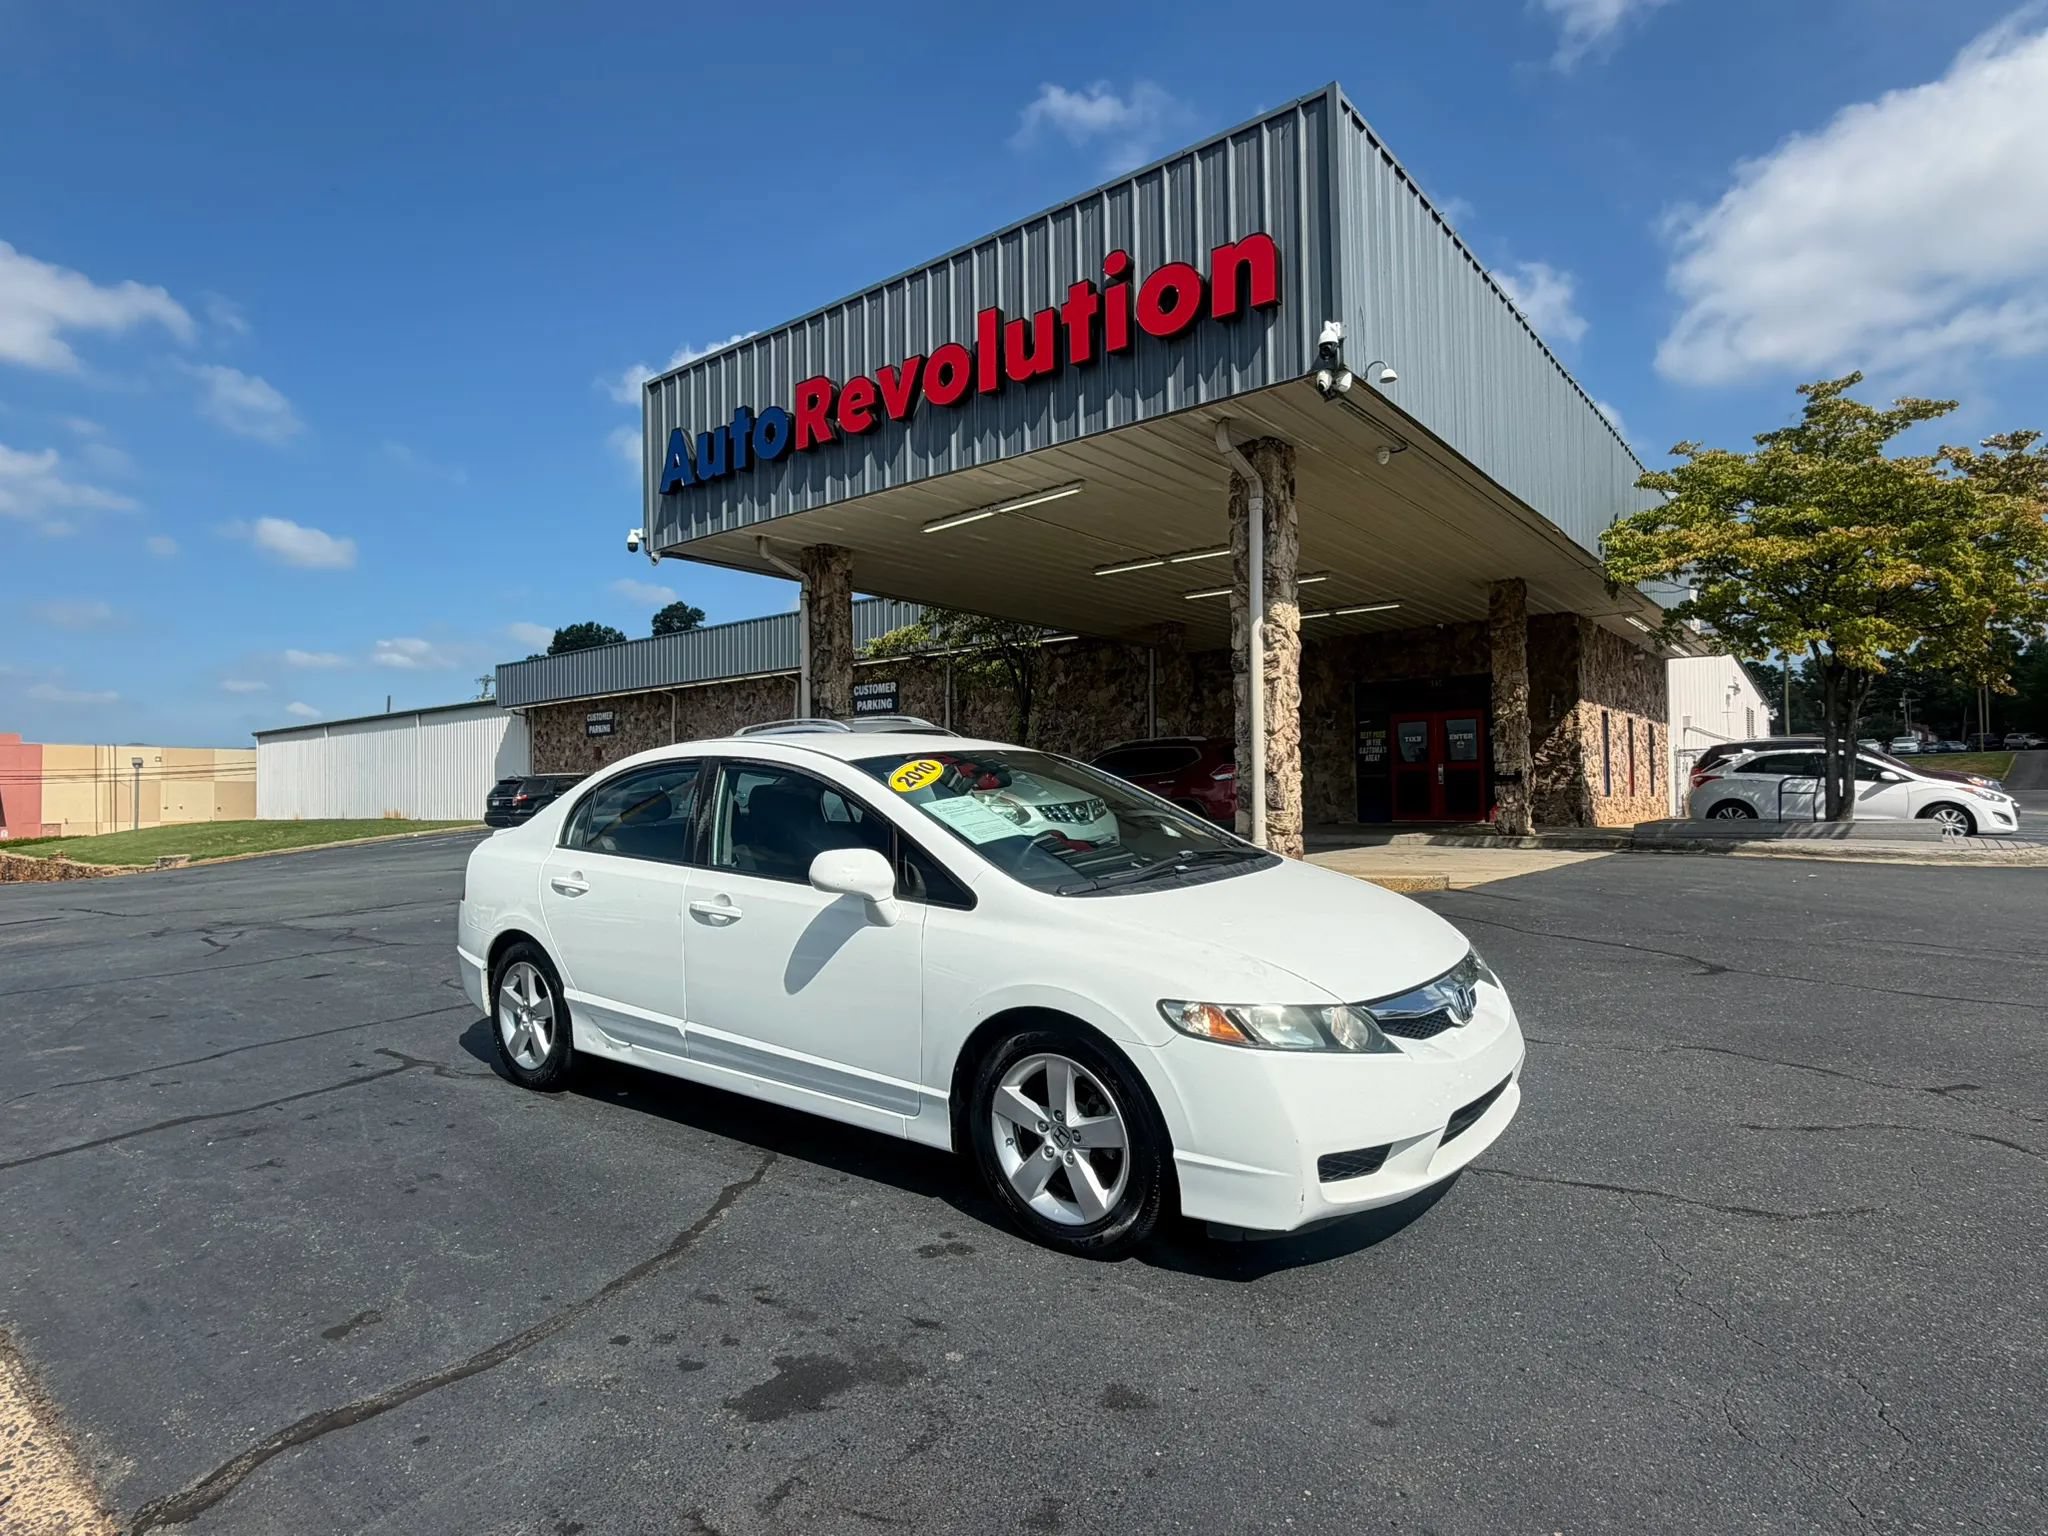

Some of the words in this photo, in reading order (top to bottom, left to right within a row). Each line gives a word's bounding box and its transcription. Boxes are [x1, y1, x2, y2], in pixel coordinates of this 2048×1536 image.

[659, 231, 1282, 494] AutoRevolution
[853, 681, 897, 697] CUSTOMER
[856, 697, 893, 712] PARKING
[587, 711, 614, 722] CUSTOMER
[588, 723, 611, 734] PARKING
[896, 761, 937, 788] 2010
